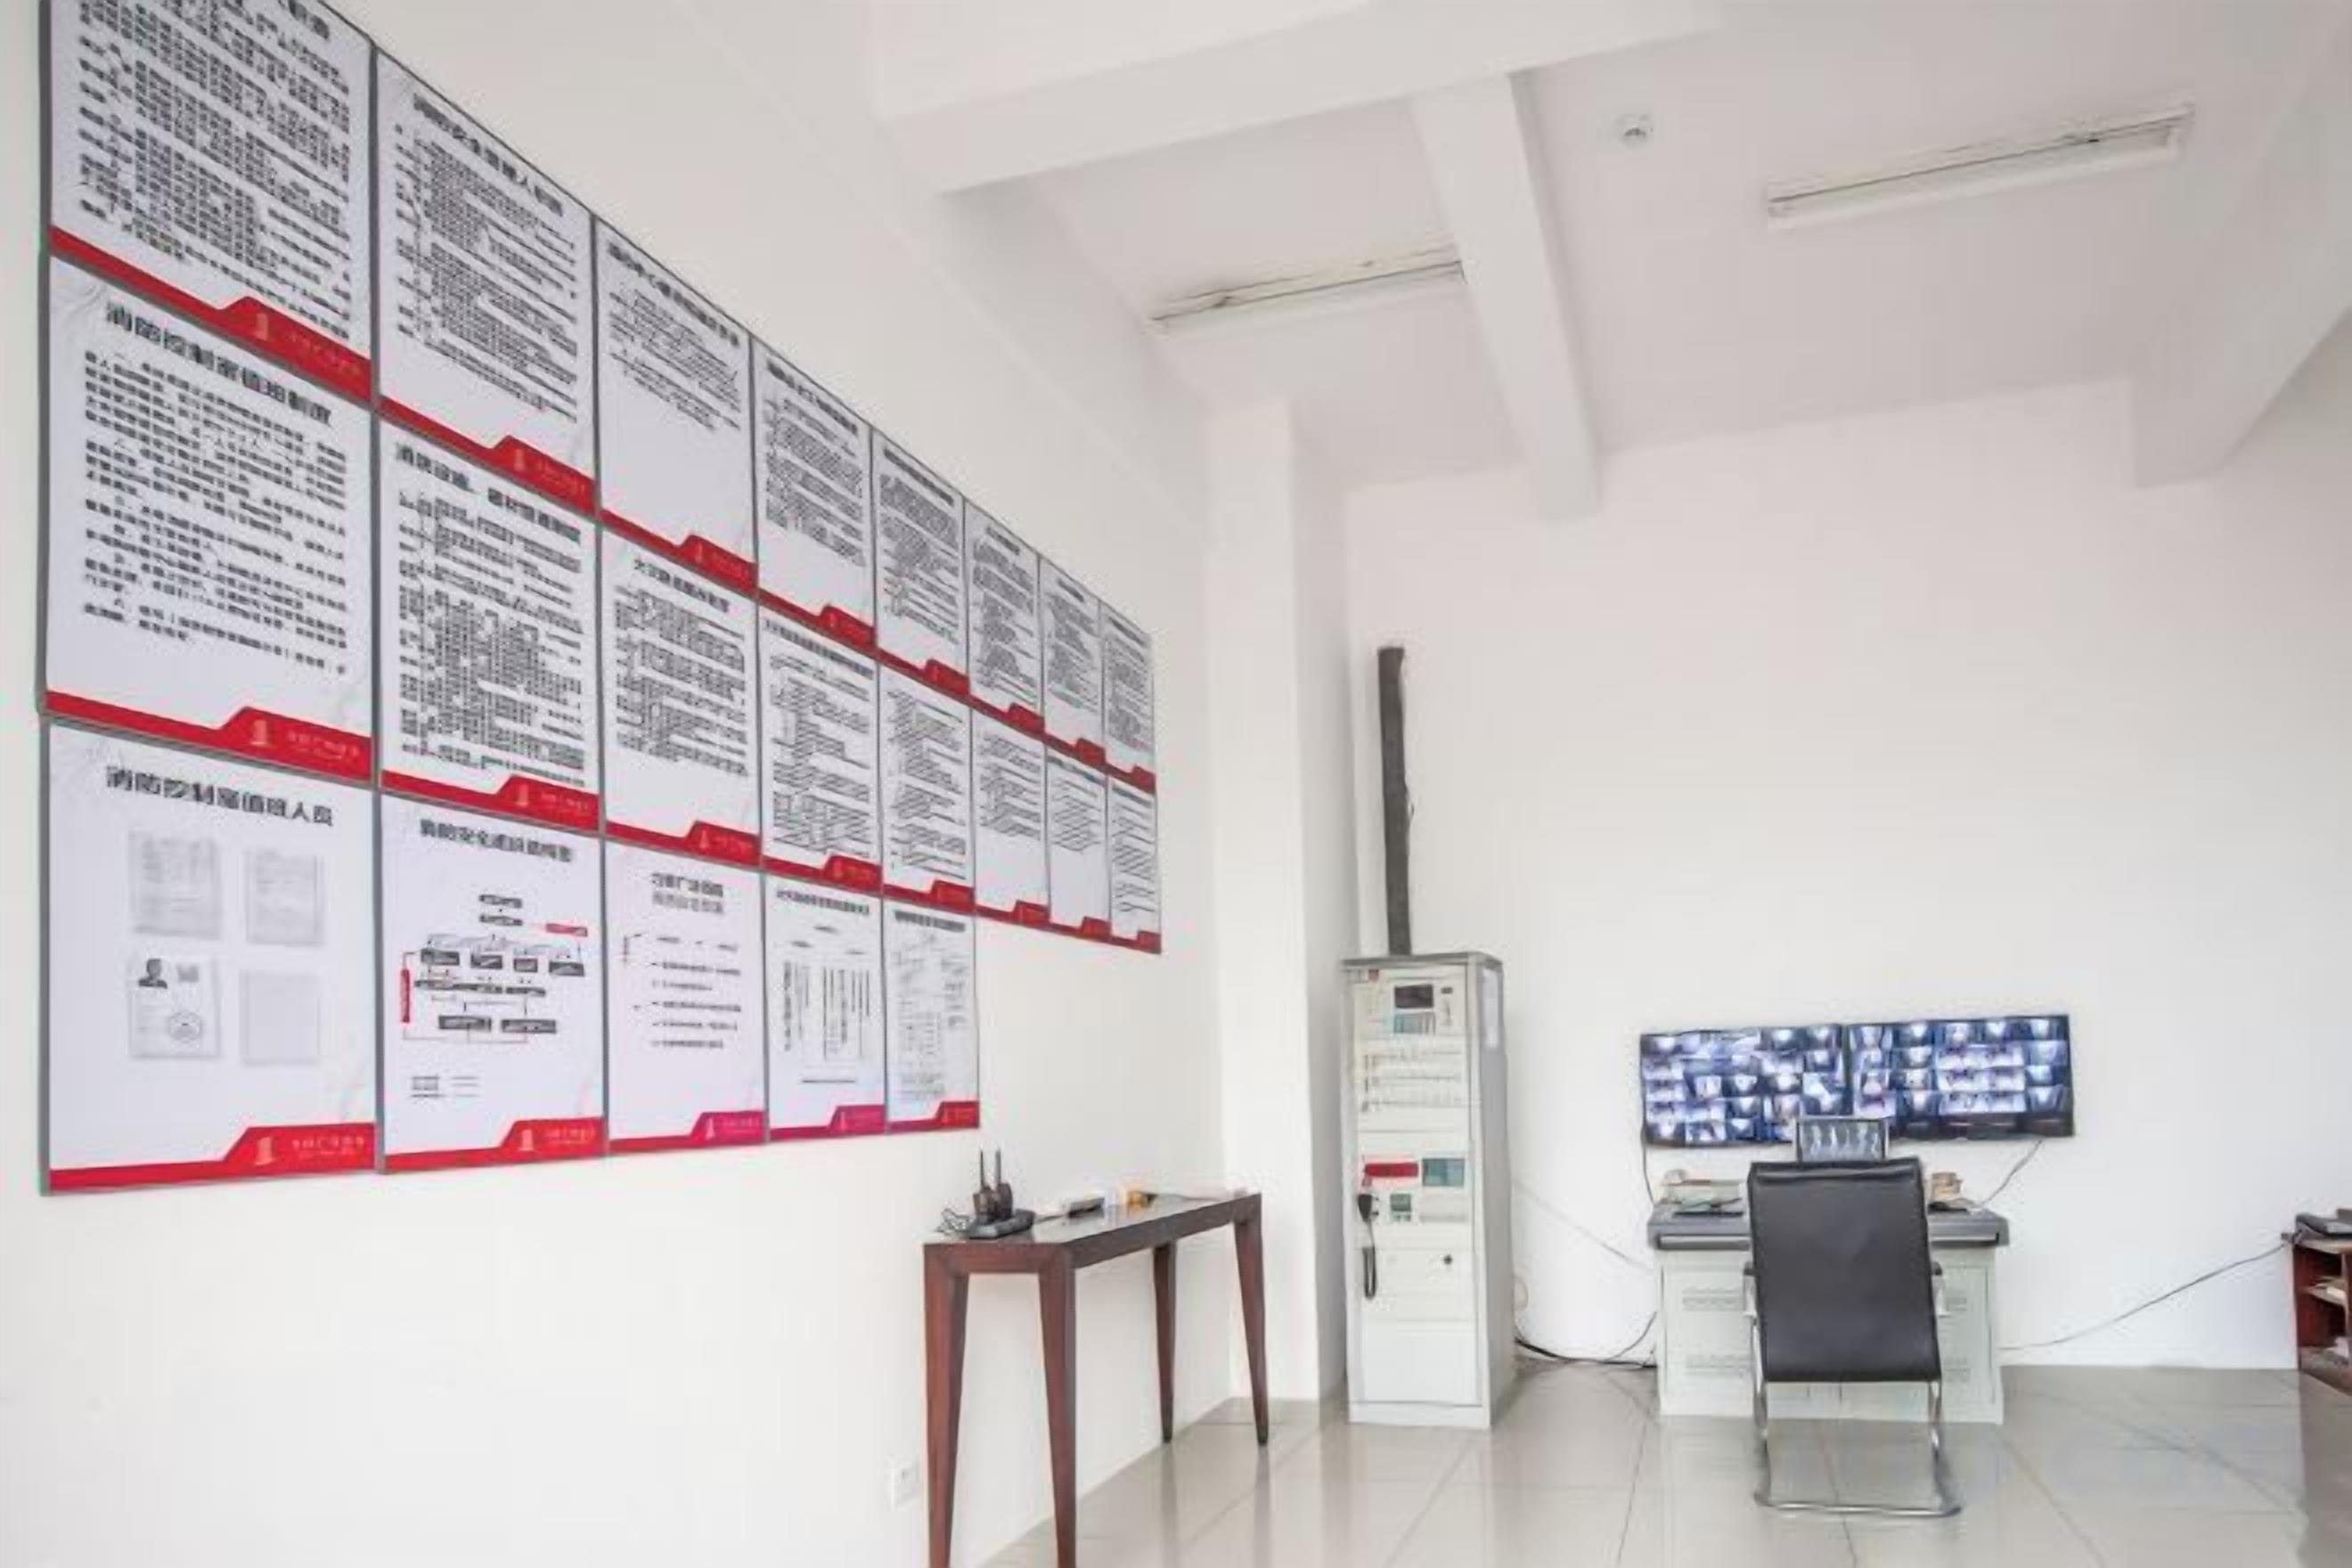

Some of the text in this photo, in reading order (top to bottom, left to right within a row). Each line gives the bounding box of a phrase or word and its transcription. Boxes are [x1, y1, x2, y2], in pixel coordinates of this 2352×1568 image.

[106, 765, 333, 827] 消防控制室值班人员
